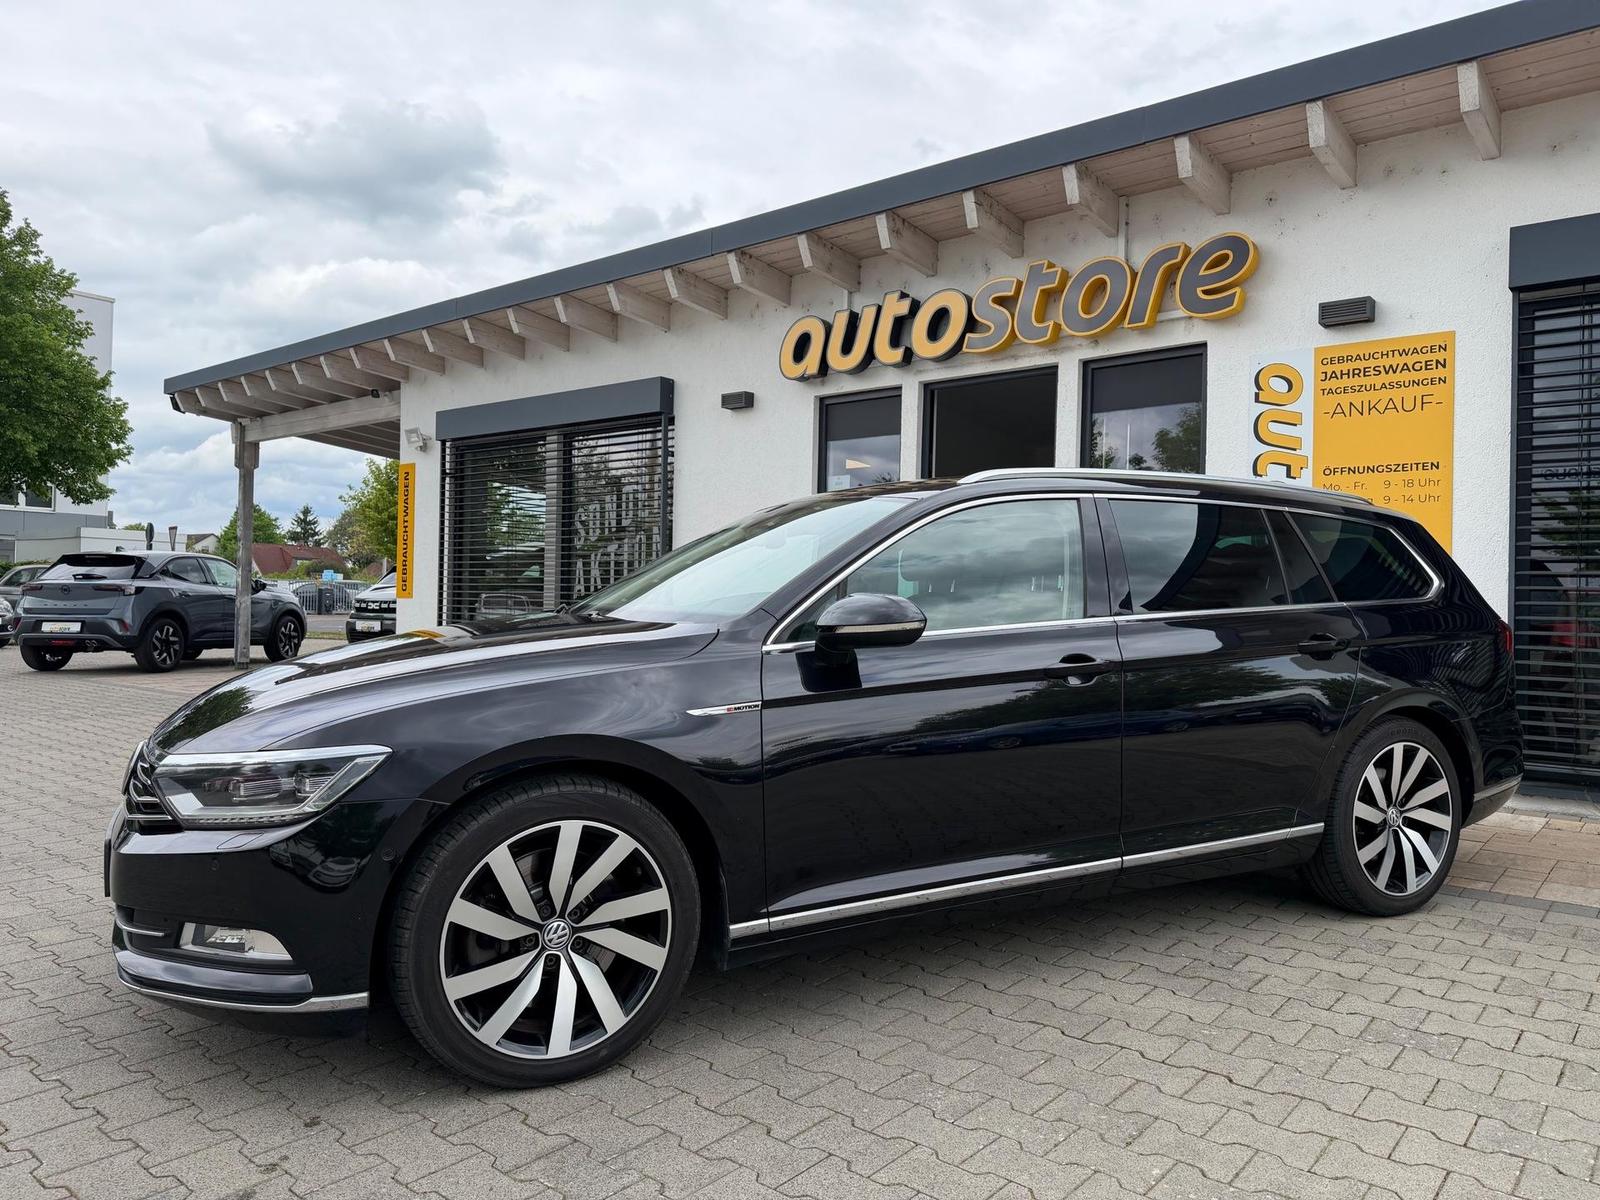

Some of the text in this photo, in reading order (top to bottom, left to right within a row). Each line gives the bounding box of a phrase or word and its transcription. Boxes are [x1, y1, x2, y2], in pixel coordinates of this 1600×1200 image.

[779, 231, 1259, 381] autostore
[1320, 344, 1448, 366] GEBRAUCHTWAGEN
[1320, 358, 1447, 382] JAHRESWAGEN
[1320, 376, 1447, 396] TAGESZULASSUNGEN
[1253, 362, 1309, 483] aut
[1322, 461, 1440, 476] ÖFFNUNGSZEITEN
[1353, 481, 1367, 490] Fr.
[1383, 480, 1391, 489] 9
[1402, 479, 1414, 488] 18
[1418, 478, 1440, 488] Uhr
[1383, 495, 1391, 504] 9
[1402, 495, 1414, 503] 14
[1418, 493, 1440, 503] Uhr
[401, 471, 410, 592] GEBRAUCHTWAGEN
